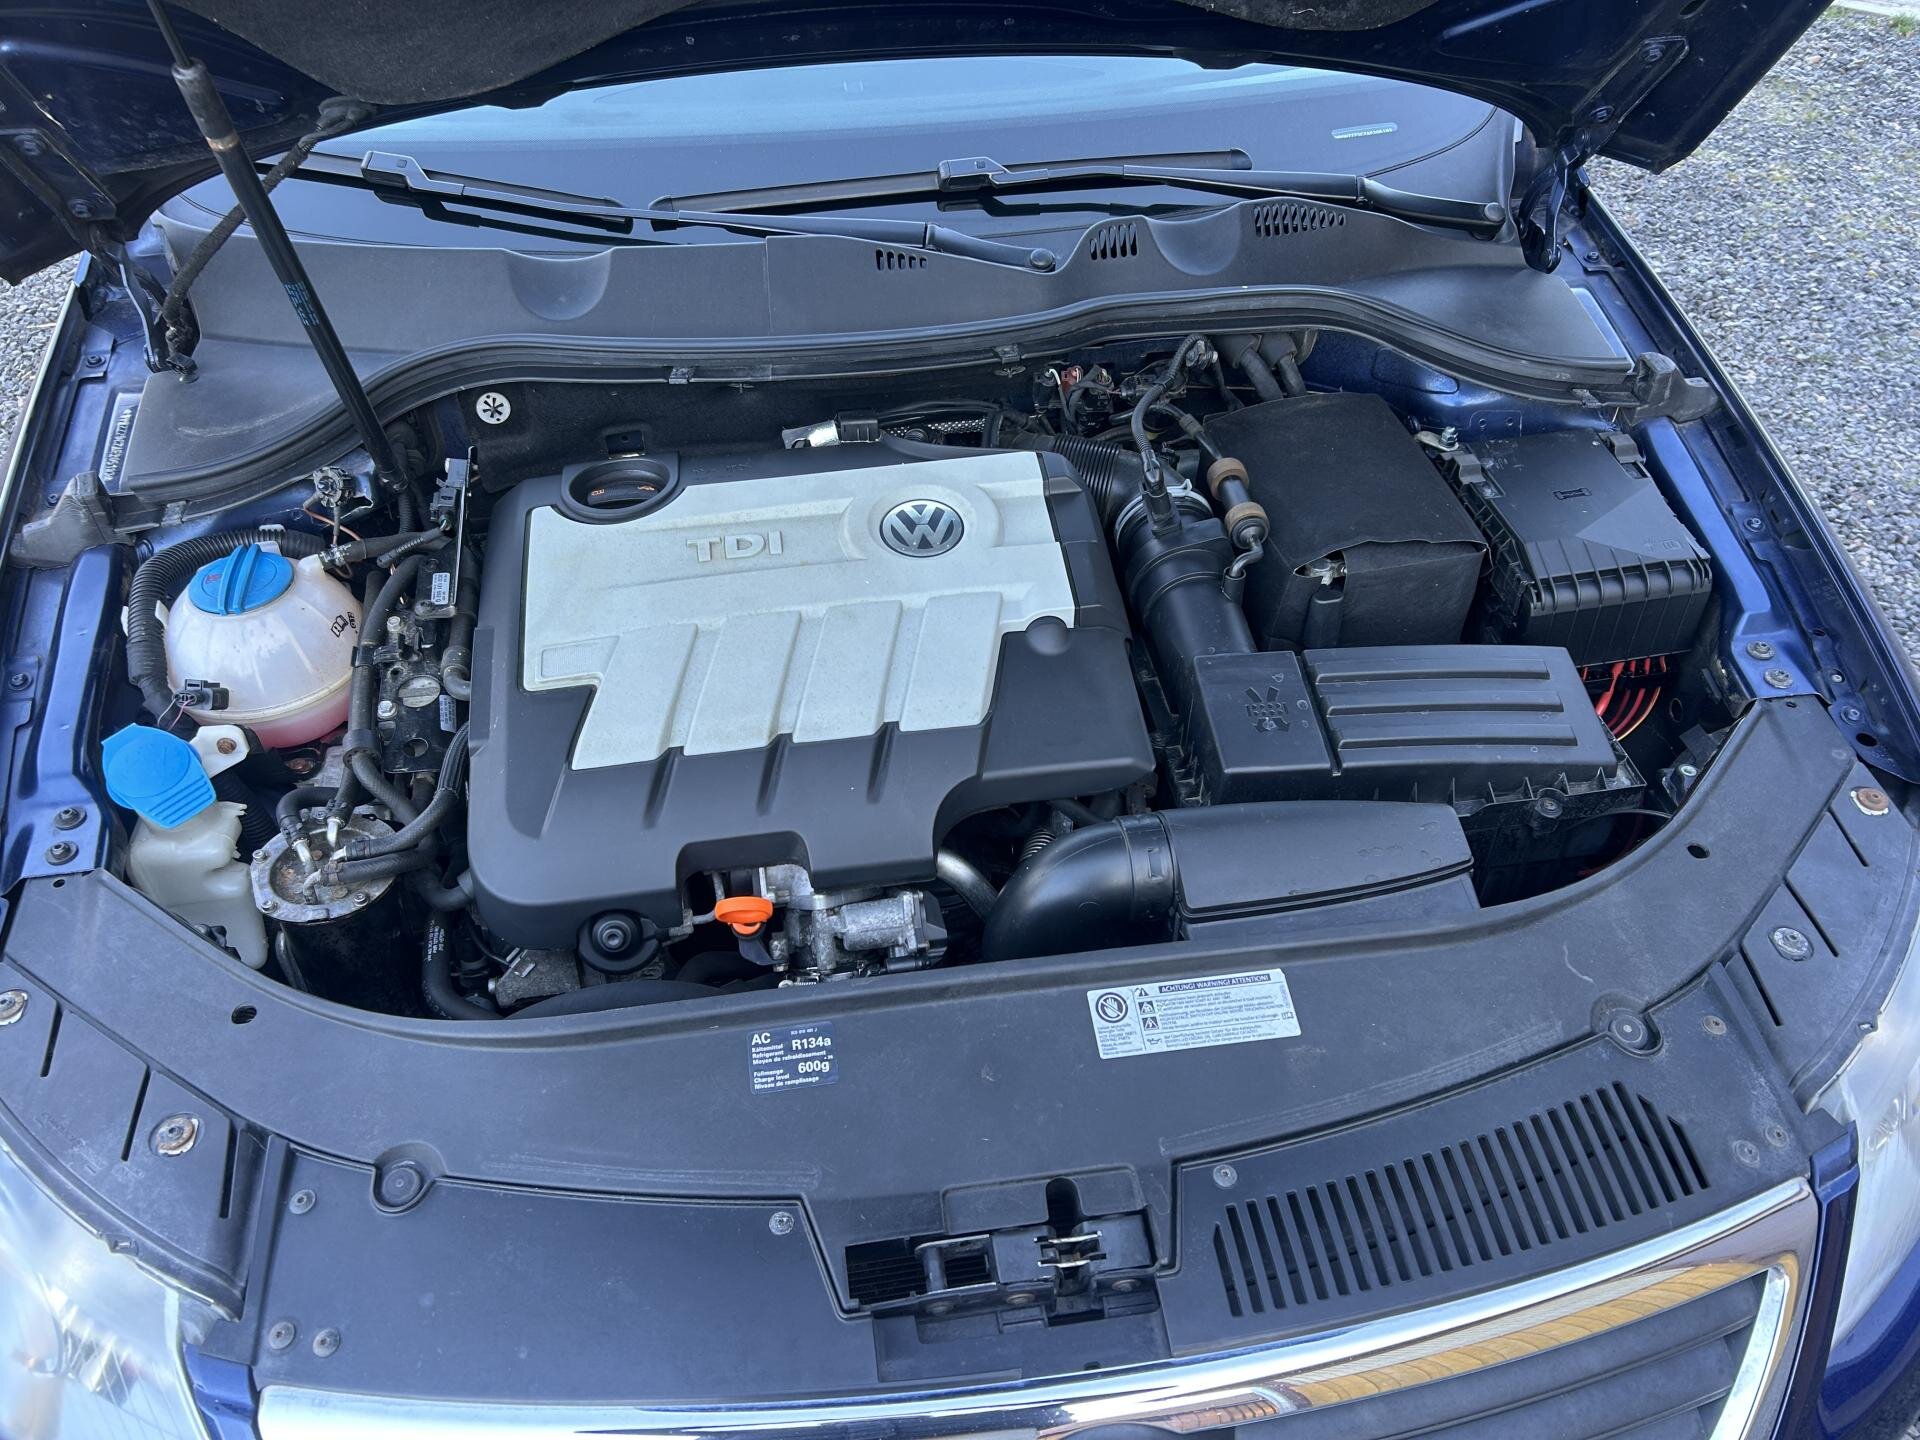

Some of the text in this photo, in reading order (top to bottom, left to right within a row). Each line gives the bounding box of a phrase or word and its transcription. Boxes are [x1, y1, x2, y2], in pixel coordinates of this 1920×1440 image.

[686, 530, 783, 563] TDI
[1161, 974, 1269, 992] ACHTUNG! WARNING! ATTENTION!
[752, 1032, 771, 1045] AC
[791, 1036, 832, 1051] R134a
[798, 1060, 830, 1074] 600g
